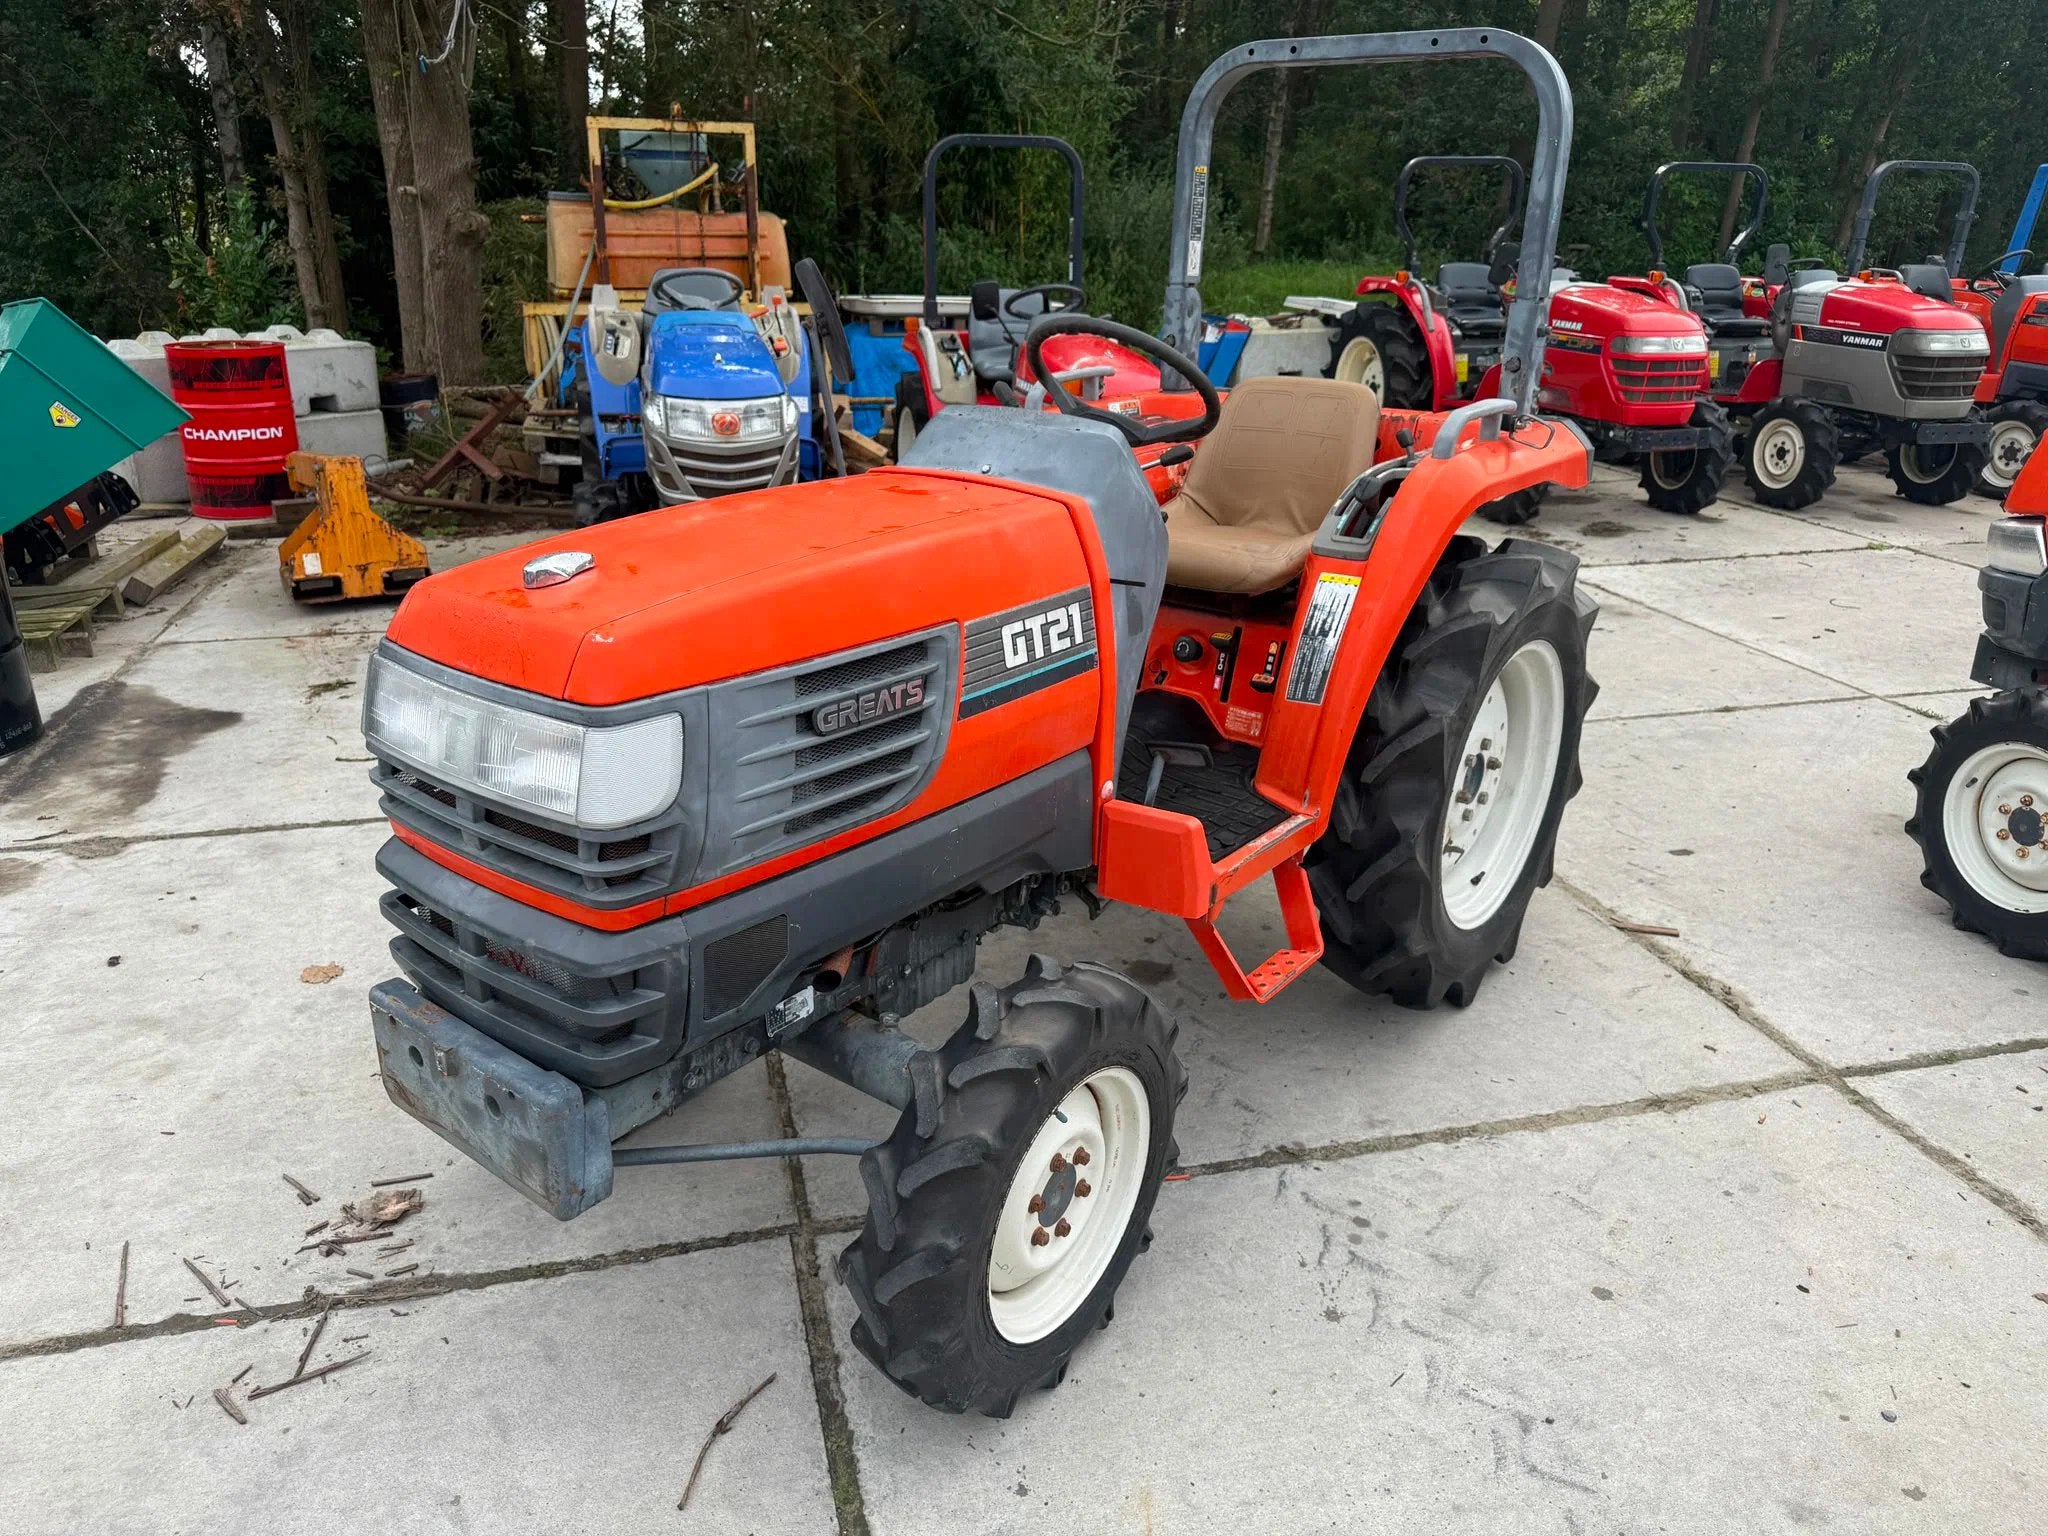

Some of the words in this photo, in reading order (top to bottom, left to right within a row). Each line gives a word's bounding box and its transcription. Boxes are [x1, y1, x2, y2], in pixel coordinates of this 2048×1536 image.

[1552, 319, 1583, 332] YANMAR
[1842, 334, 1884, 348] YANMAR
[183, 427, 283, 440] CHAMPION
[1001, 602, 1084, 669] GT21
[817, 678, 924, 733] GREATS
